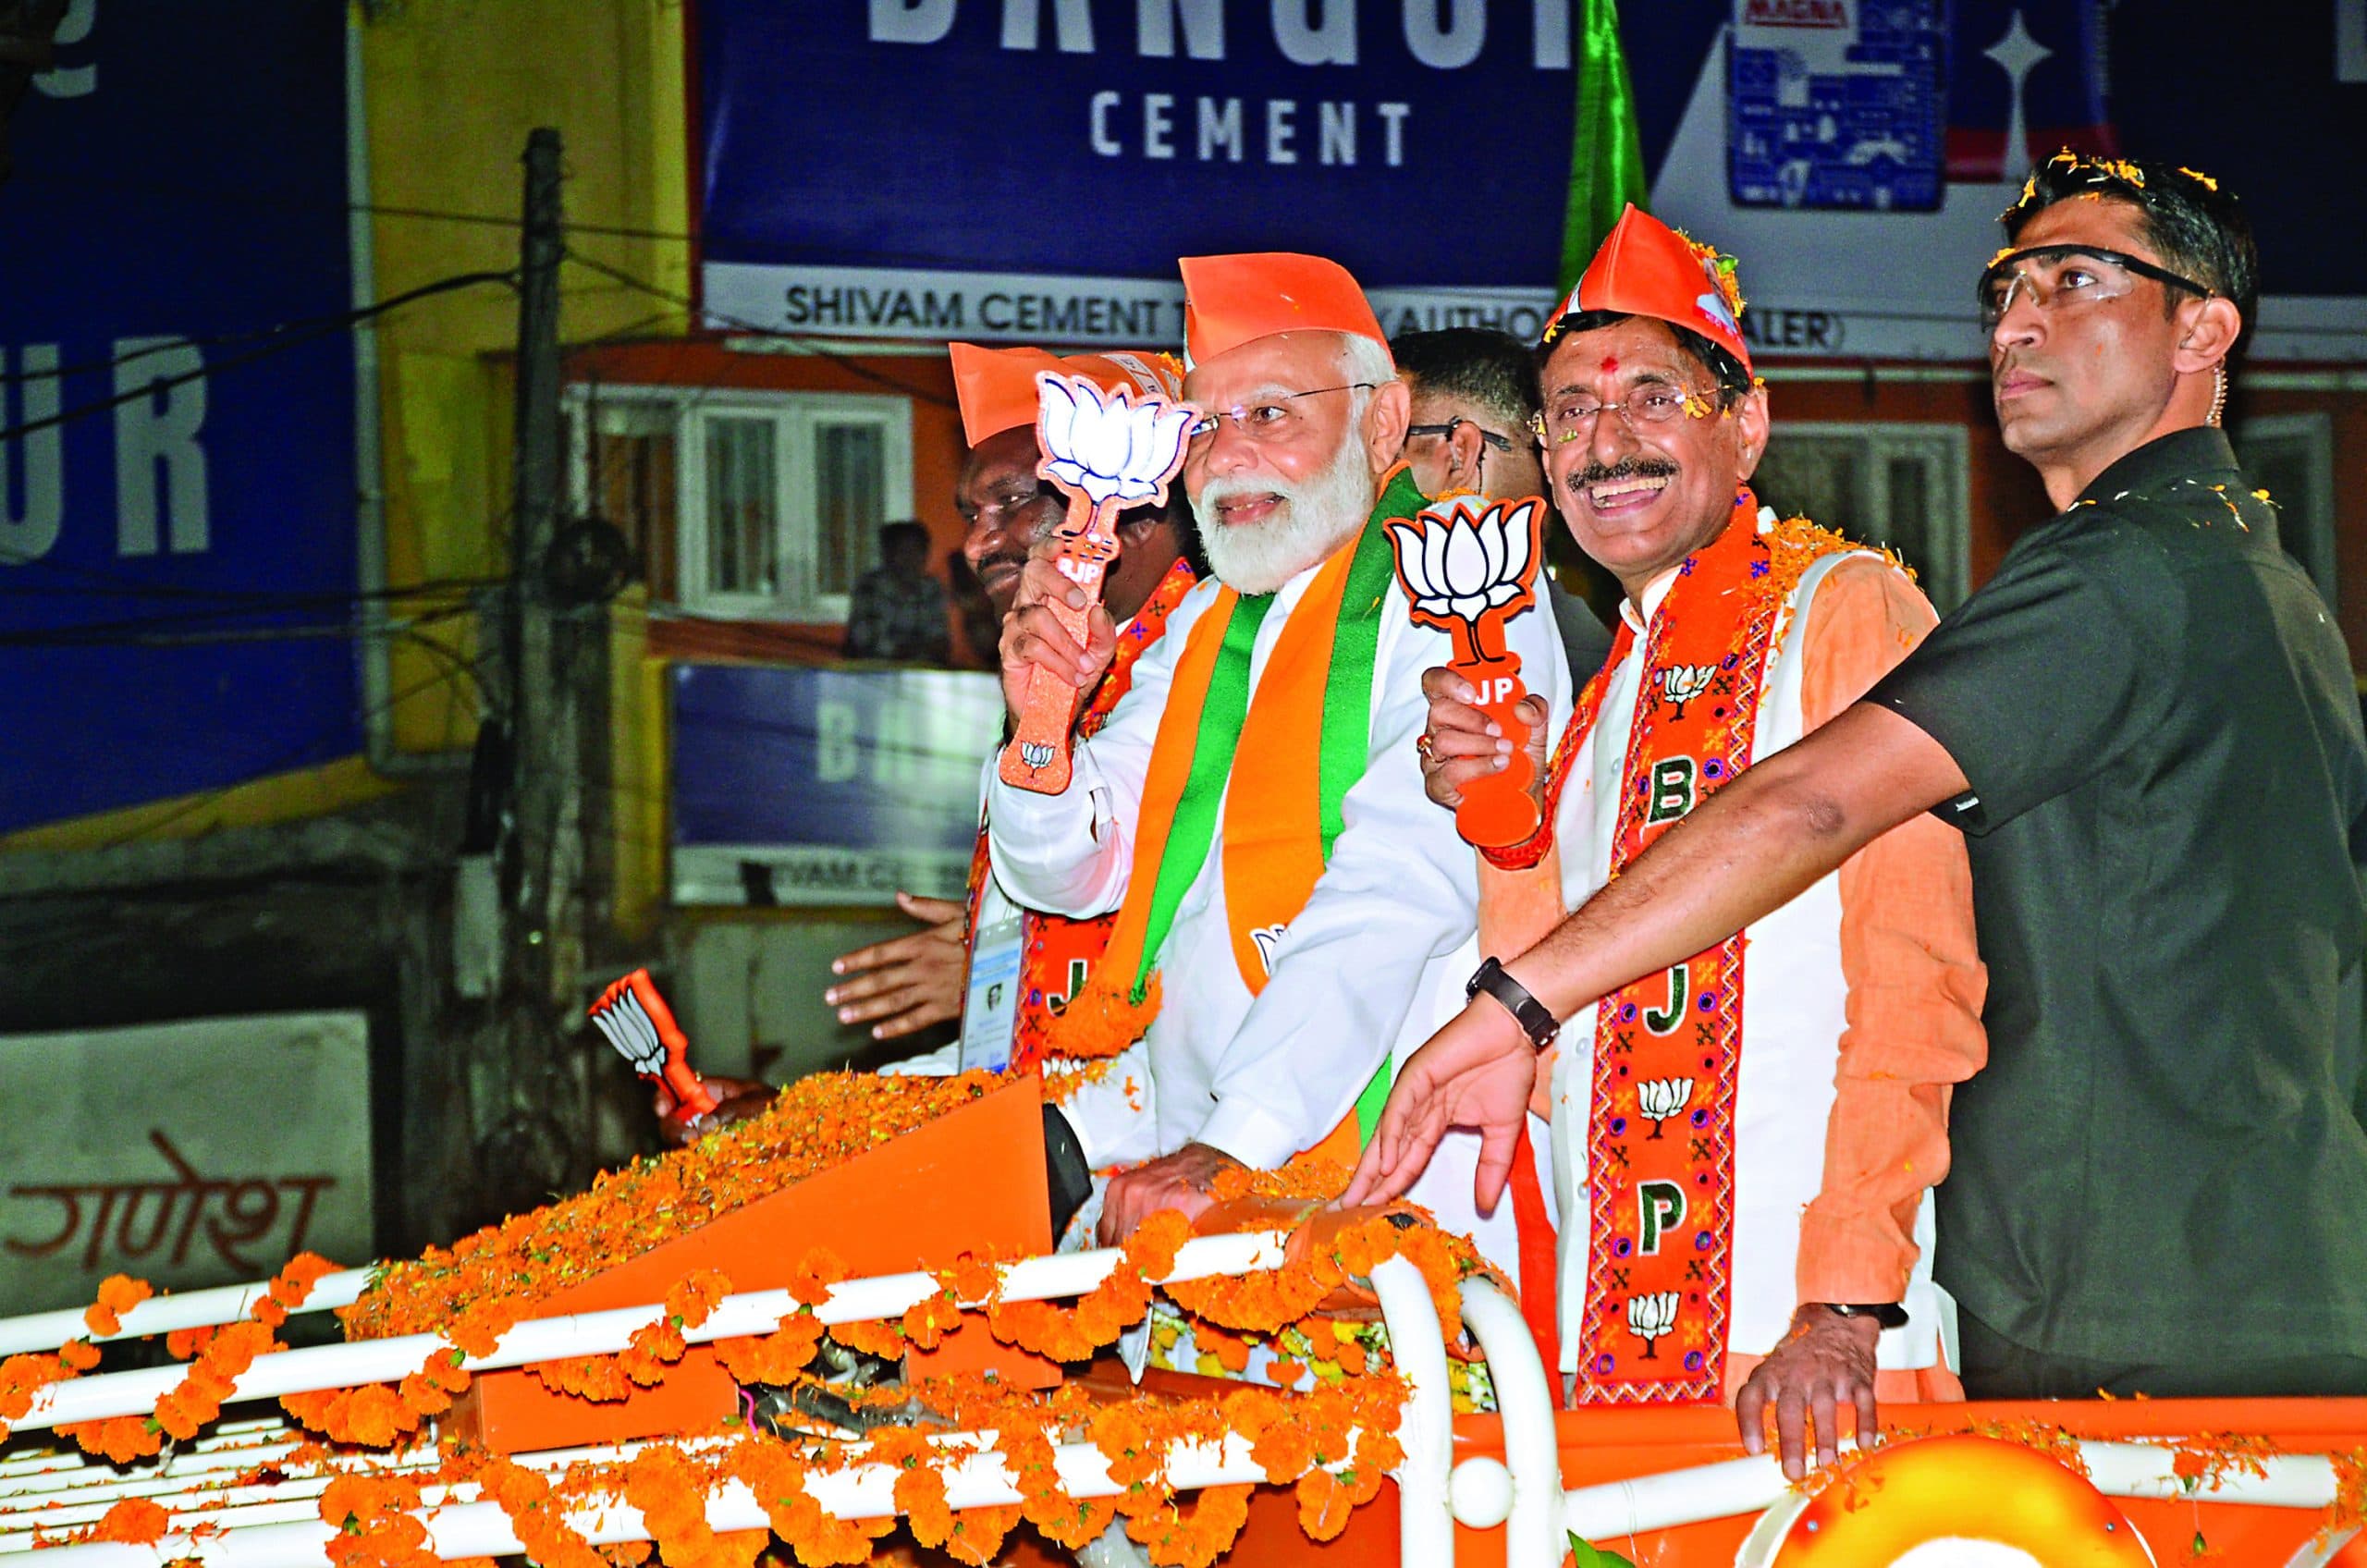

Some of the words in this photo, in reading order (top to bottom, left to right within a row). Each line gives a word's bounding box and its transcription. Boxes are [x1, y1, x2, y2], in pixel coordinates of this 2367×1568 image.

[1089, 90, 1411, 167] CEMENT
[785, 285, 965, 330] SHIVAM
[977, 293, 1162, 336] CEMENT
[1474, 677, 1514, 706] JP
[4, 1128, 336, 1275] गणेश
[1637, 1179, 1687, 1256] P
